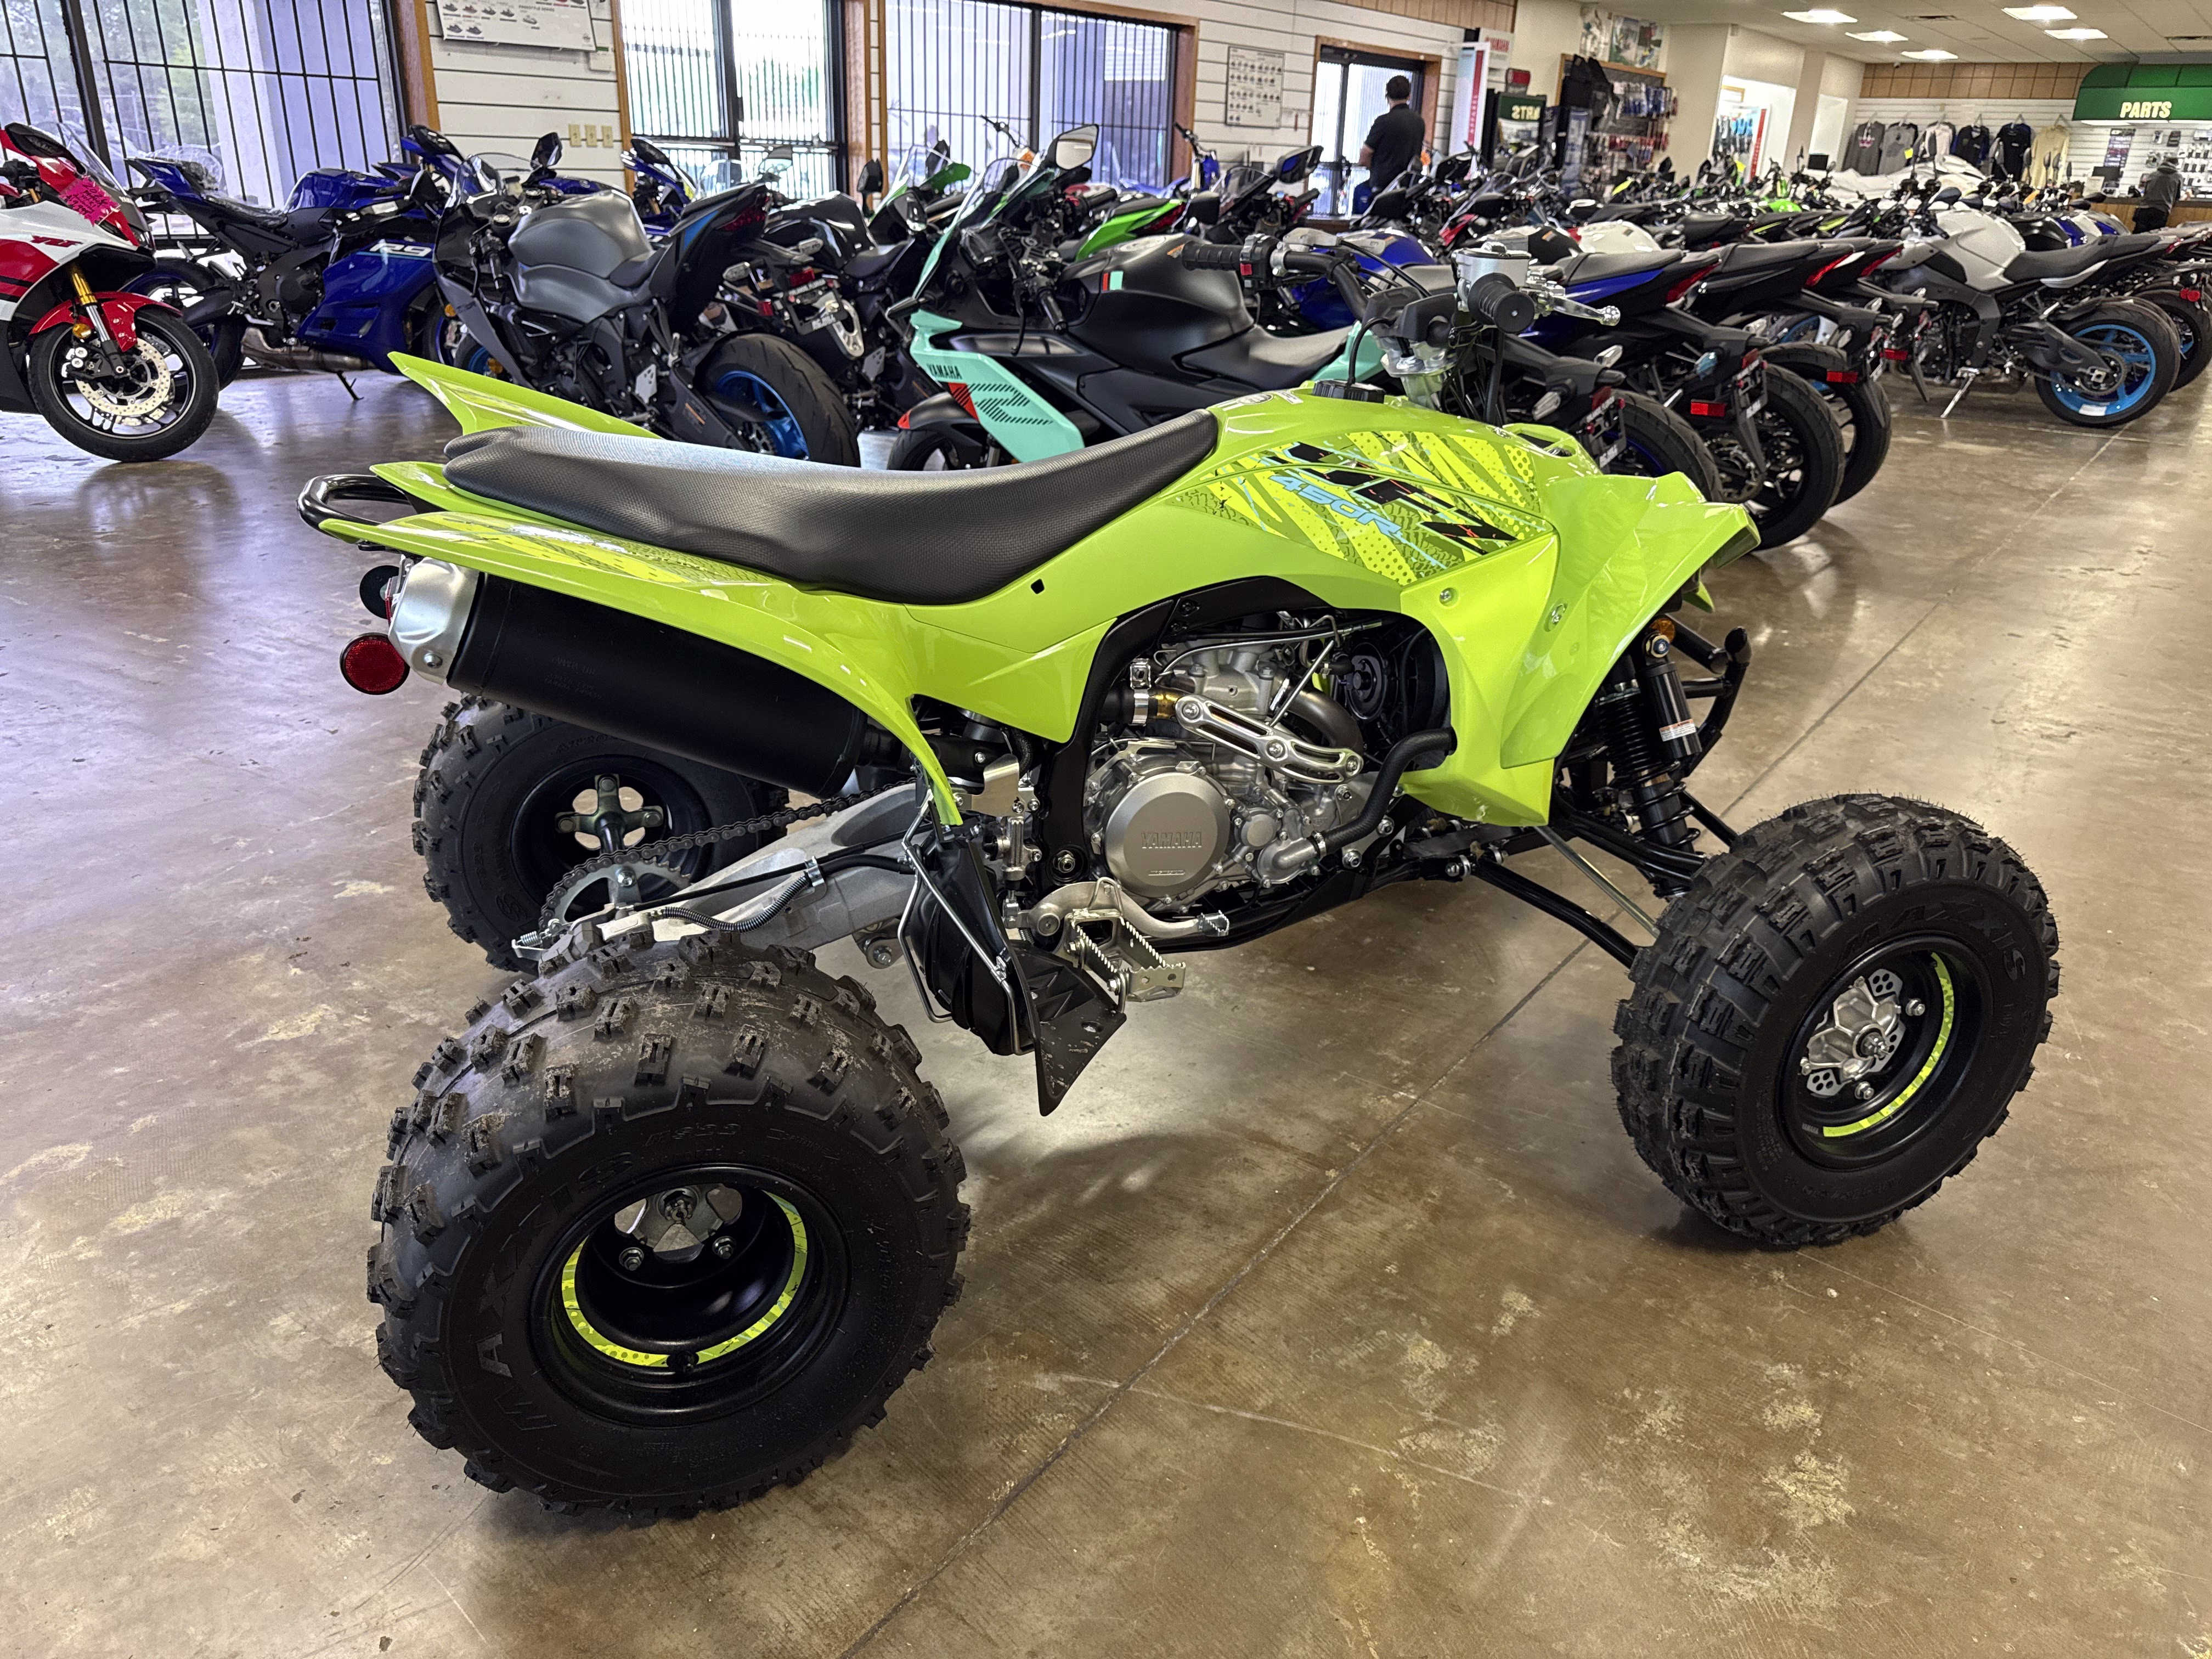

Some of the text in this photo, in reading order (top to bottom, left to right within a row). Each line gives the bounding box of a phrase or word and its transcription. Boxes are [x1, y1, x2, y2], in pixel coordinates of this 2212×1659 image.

[2120, 101, 2172, 118] PARTS
[369, 242, 432, 257] R9
[926, 363, 962, 380] YAMAHA
[1268, 475, 1404, 539] 450R
[1141, 832, 1202, 849] YAMAHA
